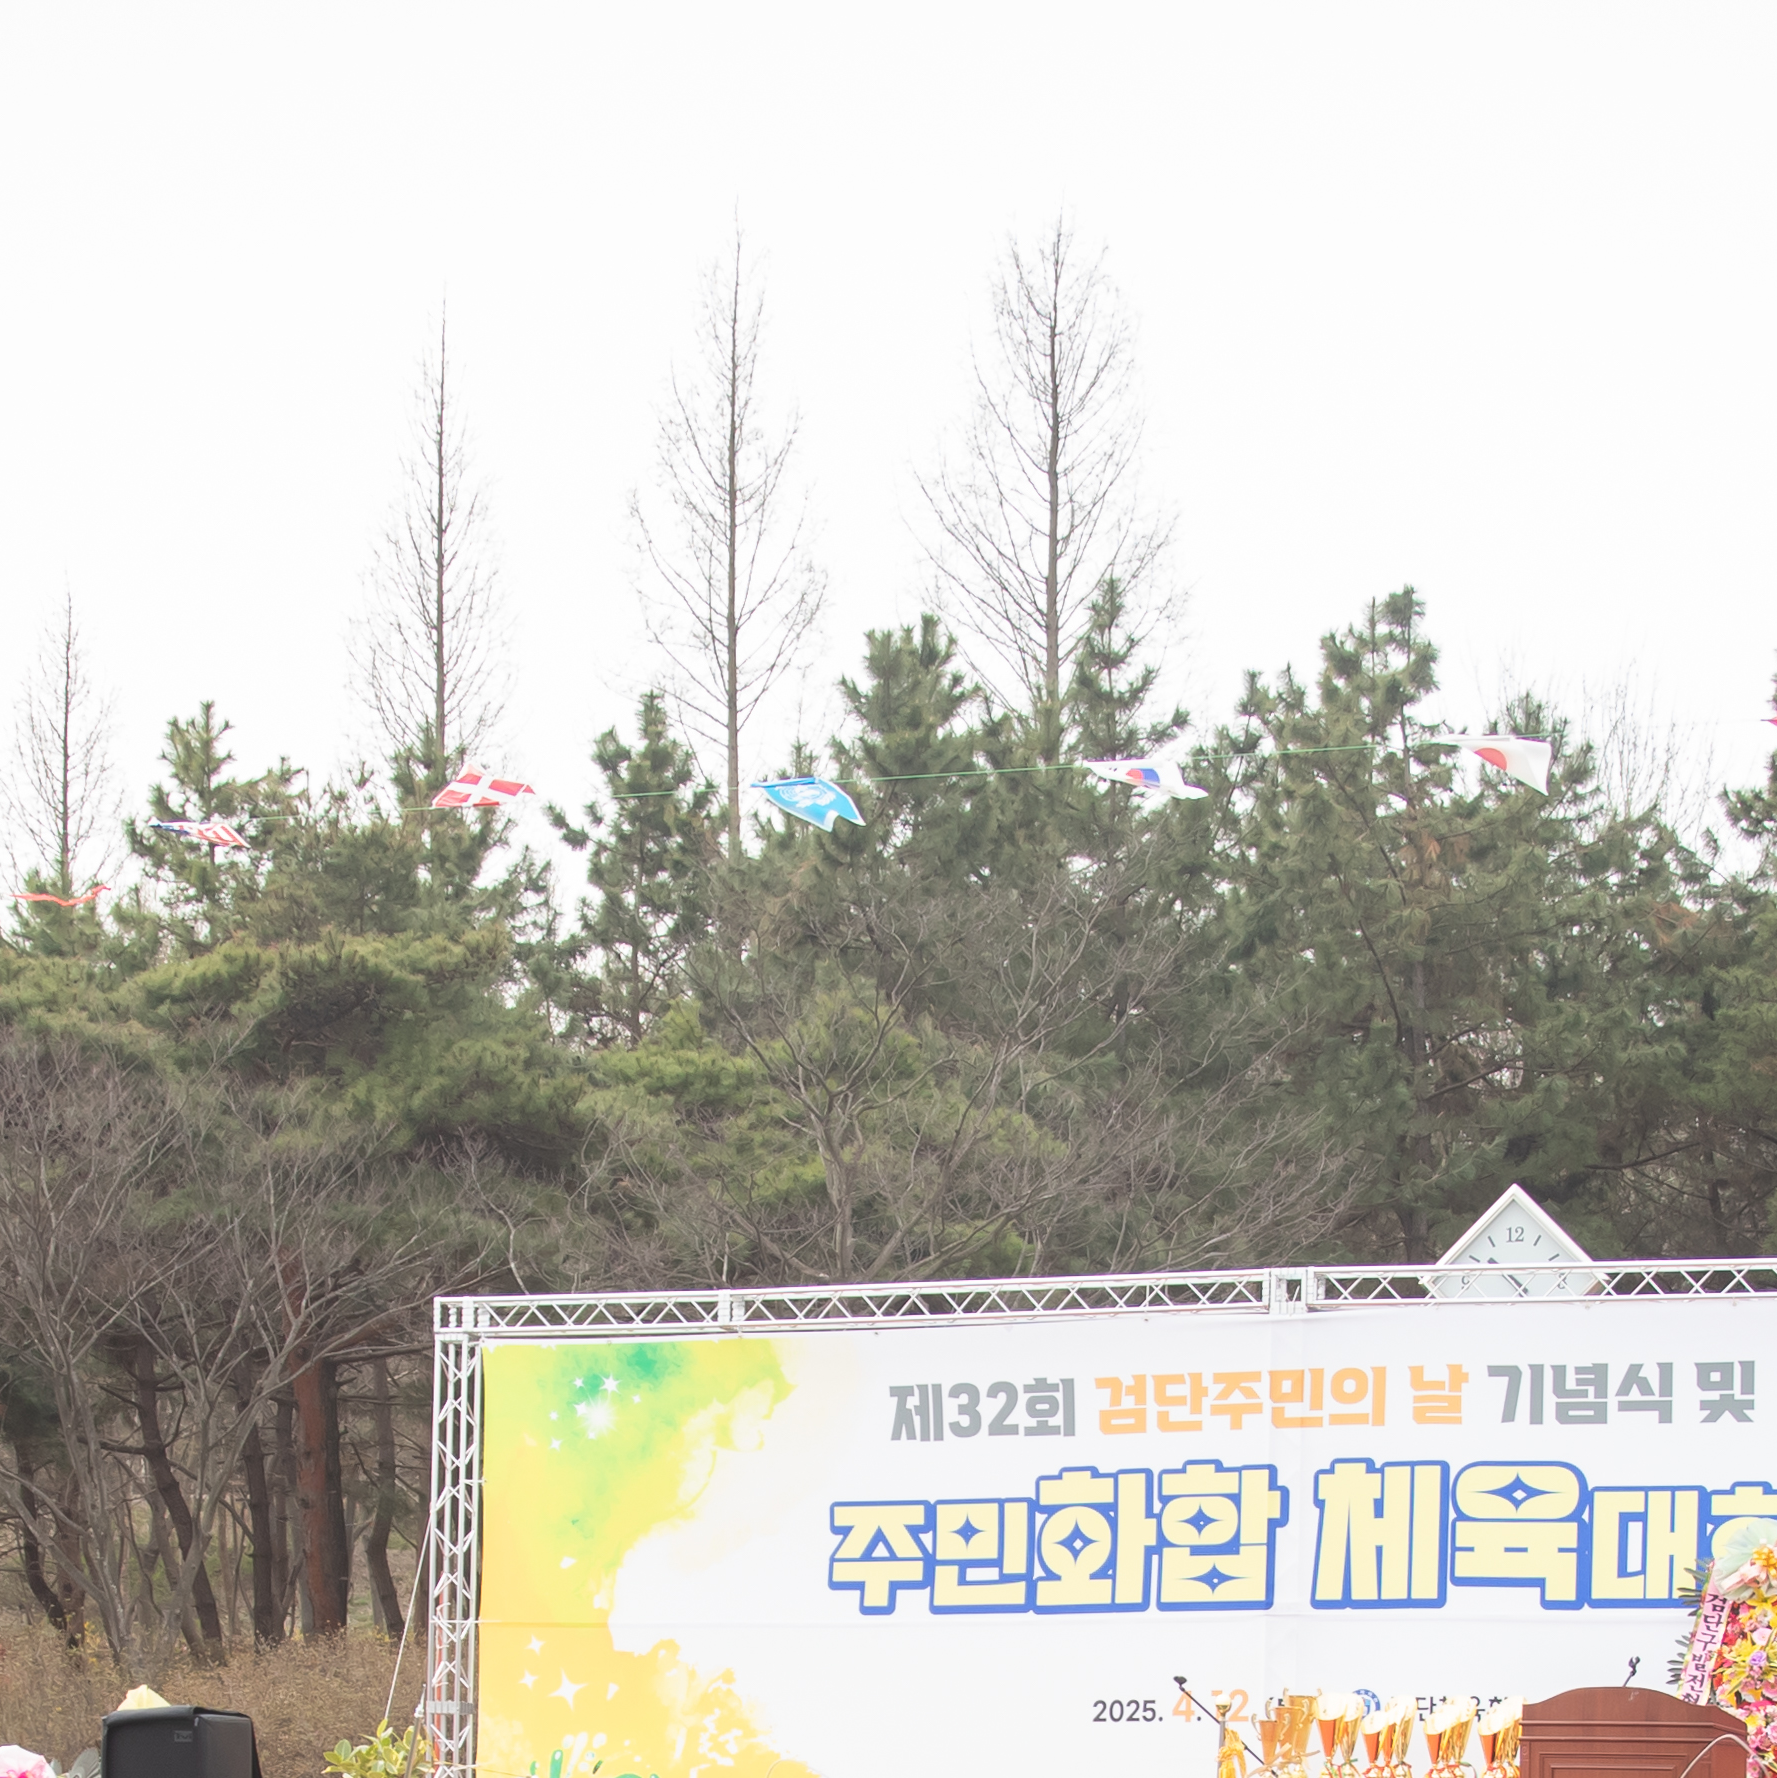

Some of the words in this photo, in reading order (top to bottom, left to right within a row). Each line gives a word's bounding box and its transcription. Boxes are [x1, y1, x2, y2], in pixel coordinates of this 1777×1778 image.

[1506, 1227, 1524, 1242] 12
[889, 1377, 1075, 1442] 제32회
[1094, 1365, 1387, 1436] 검단주민의
[1408, 1364, 1469, 1425] 날
[1487, 1362, 1674, 1425] 기념식
[1694, 1361, 1756, 1424] 및
[828, 1459, 1290, 1615] 주민화합
[1092, 1700, 1163, 1722] 2025.
